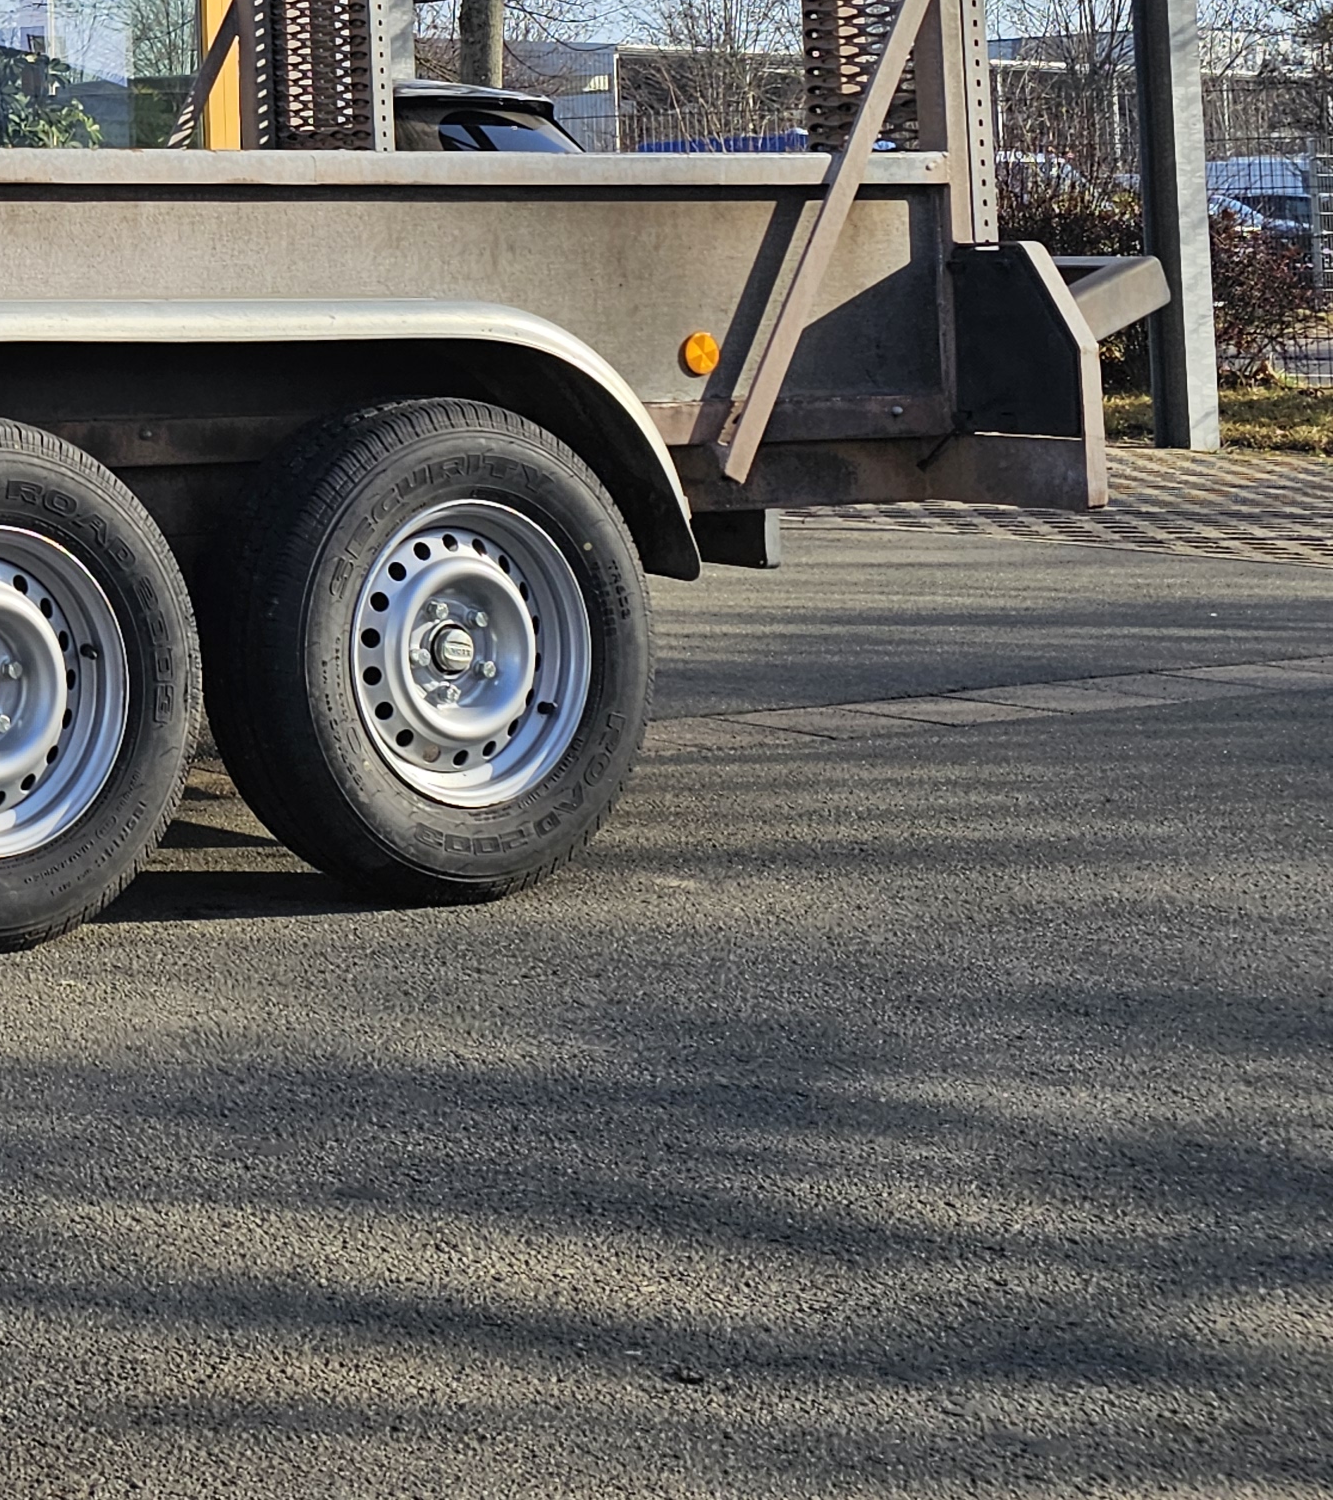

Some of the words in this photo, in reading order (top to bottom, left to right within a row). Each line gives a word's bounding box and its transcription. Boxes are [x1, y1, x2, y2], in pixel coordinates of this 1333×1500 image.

[6, 480, 136, 571] ROAD
[329, 452, 554, 599] SECURITY
[534, 712, 626, 837] ROAD
[415, 822, 529, 854] 2003
